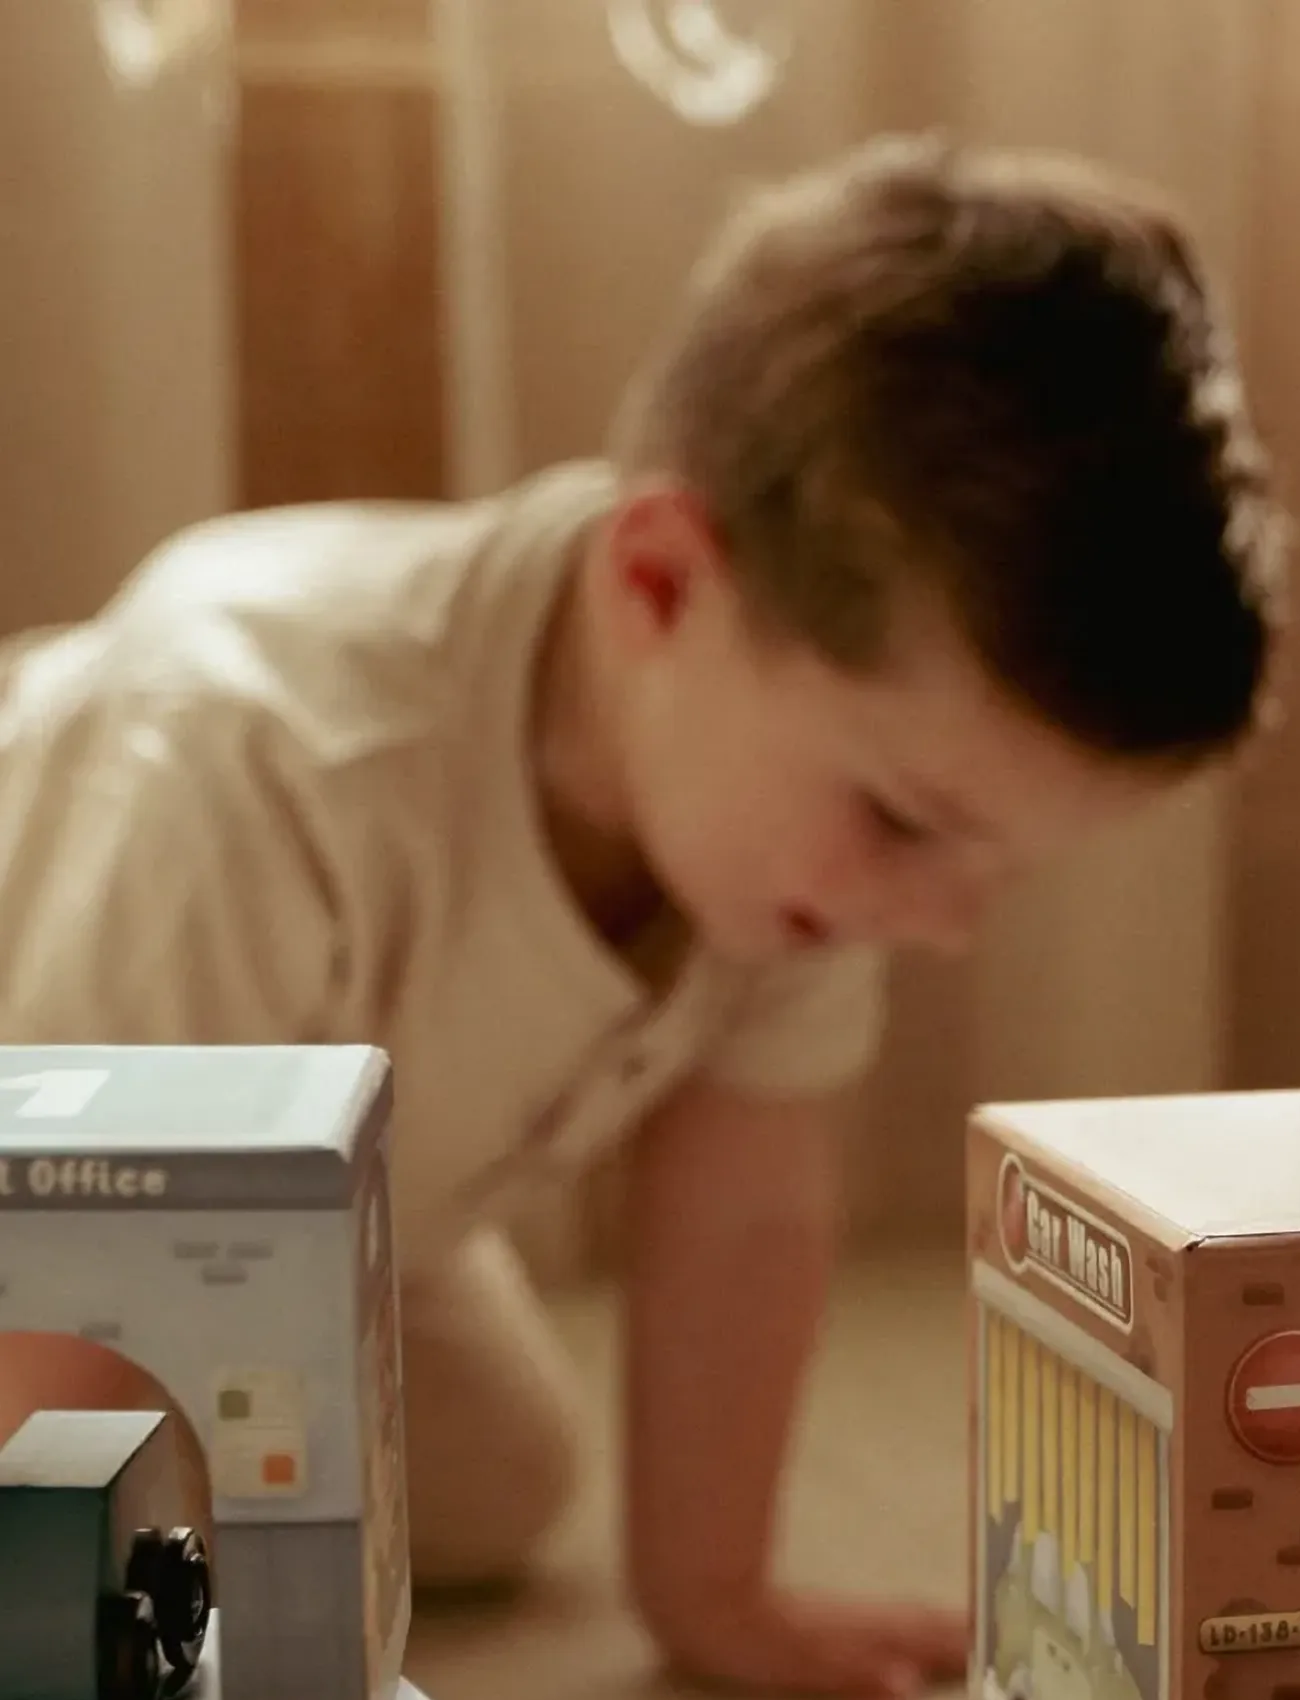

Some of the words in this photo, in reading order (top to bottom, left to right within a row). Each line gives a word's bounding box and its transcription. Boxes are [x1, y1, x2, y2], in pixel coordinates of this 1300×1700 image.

[28, 1158, 167, 1197] Office
[1027, 1190, 1062, 1266] Car
[1067, 1214, 1124, 1309] Wash
